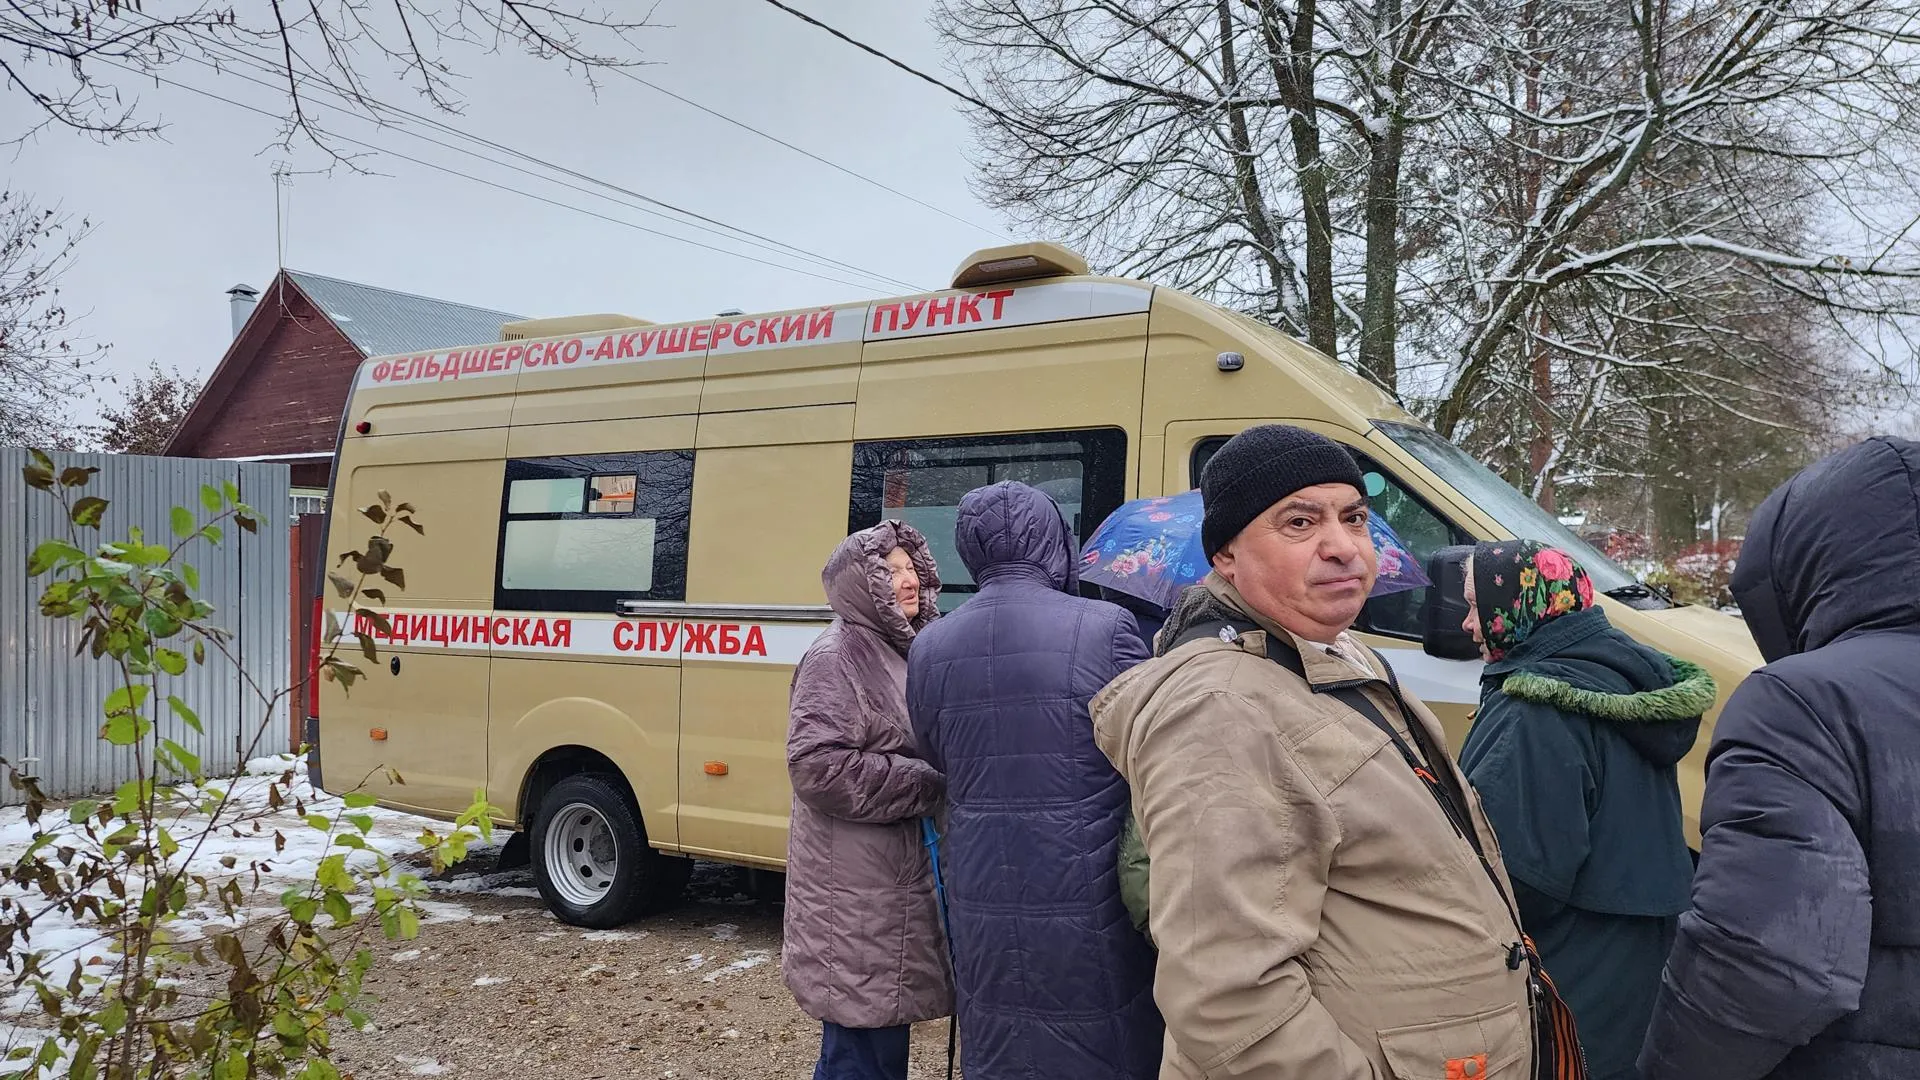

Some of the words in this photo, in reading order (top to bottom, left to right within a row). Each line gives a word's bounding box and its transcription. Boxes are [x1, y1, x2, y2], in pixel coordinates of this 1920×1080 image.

[372, 306, 835, 382] ФЕЛЬДШЕРСКО-АКУШЕРСКИЙ
[871, 289, 1015, 333] ПУНКТ
[613, 621, 767, 657] СЛУЖБА
